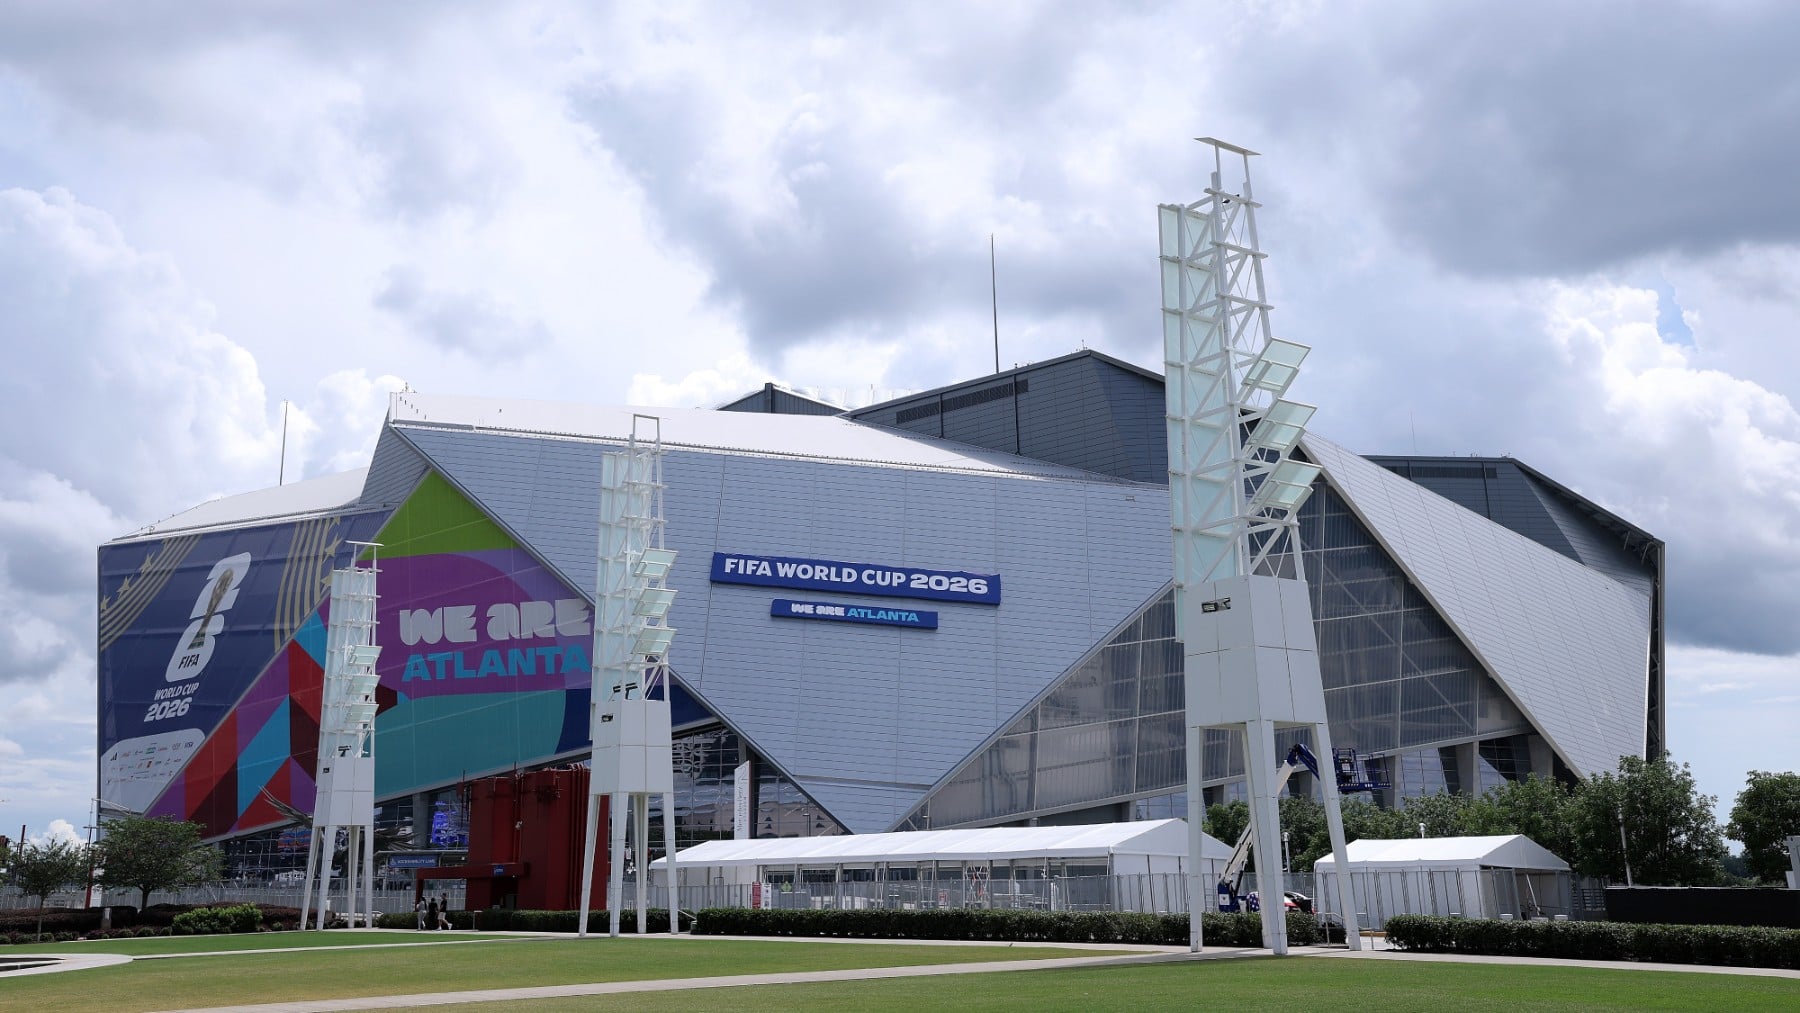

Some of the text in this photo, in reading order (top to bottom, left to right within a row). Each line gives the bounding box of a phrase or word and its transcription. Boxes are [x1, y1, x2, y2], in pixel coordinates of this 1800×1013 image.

[724, 558, 988, 594] FIFA WORLD CUP 2026
[791, 603, 815, 614] WE
[847, 608, 919, 622] ATLANTA
[399, 605, 477, 646] WE
[178, 654, 200, 669] FIFA
[401, 645, 592, 682] ATLANTA
[154, 682, 200, 701] WORLD CUP
[144, 697, 193, 722] 2026
